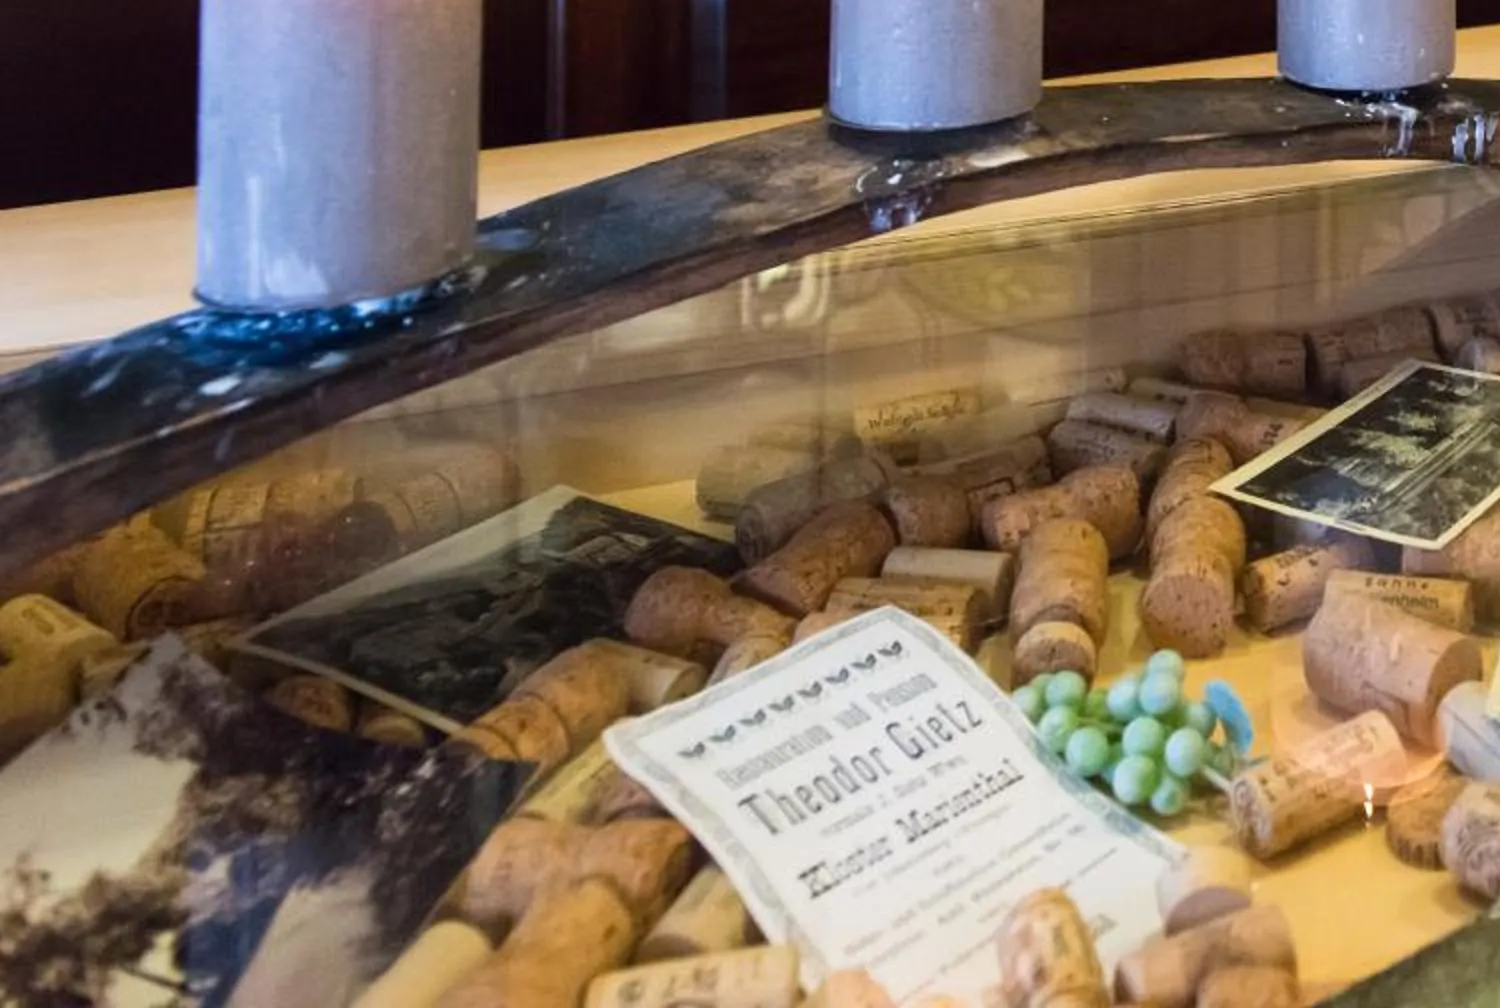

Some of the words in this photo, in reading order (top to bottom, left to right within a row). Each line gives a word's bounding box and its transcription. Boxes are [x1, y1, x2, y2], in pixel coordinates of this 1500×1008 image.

[737, 744, 895, 835] Theodor
[884, 699, 984, 760] Gietz
[797, 835, 894, 900] Kloster
